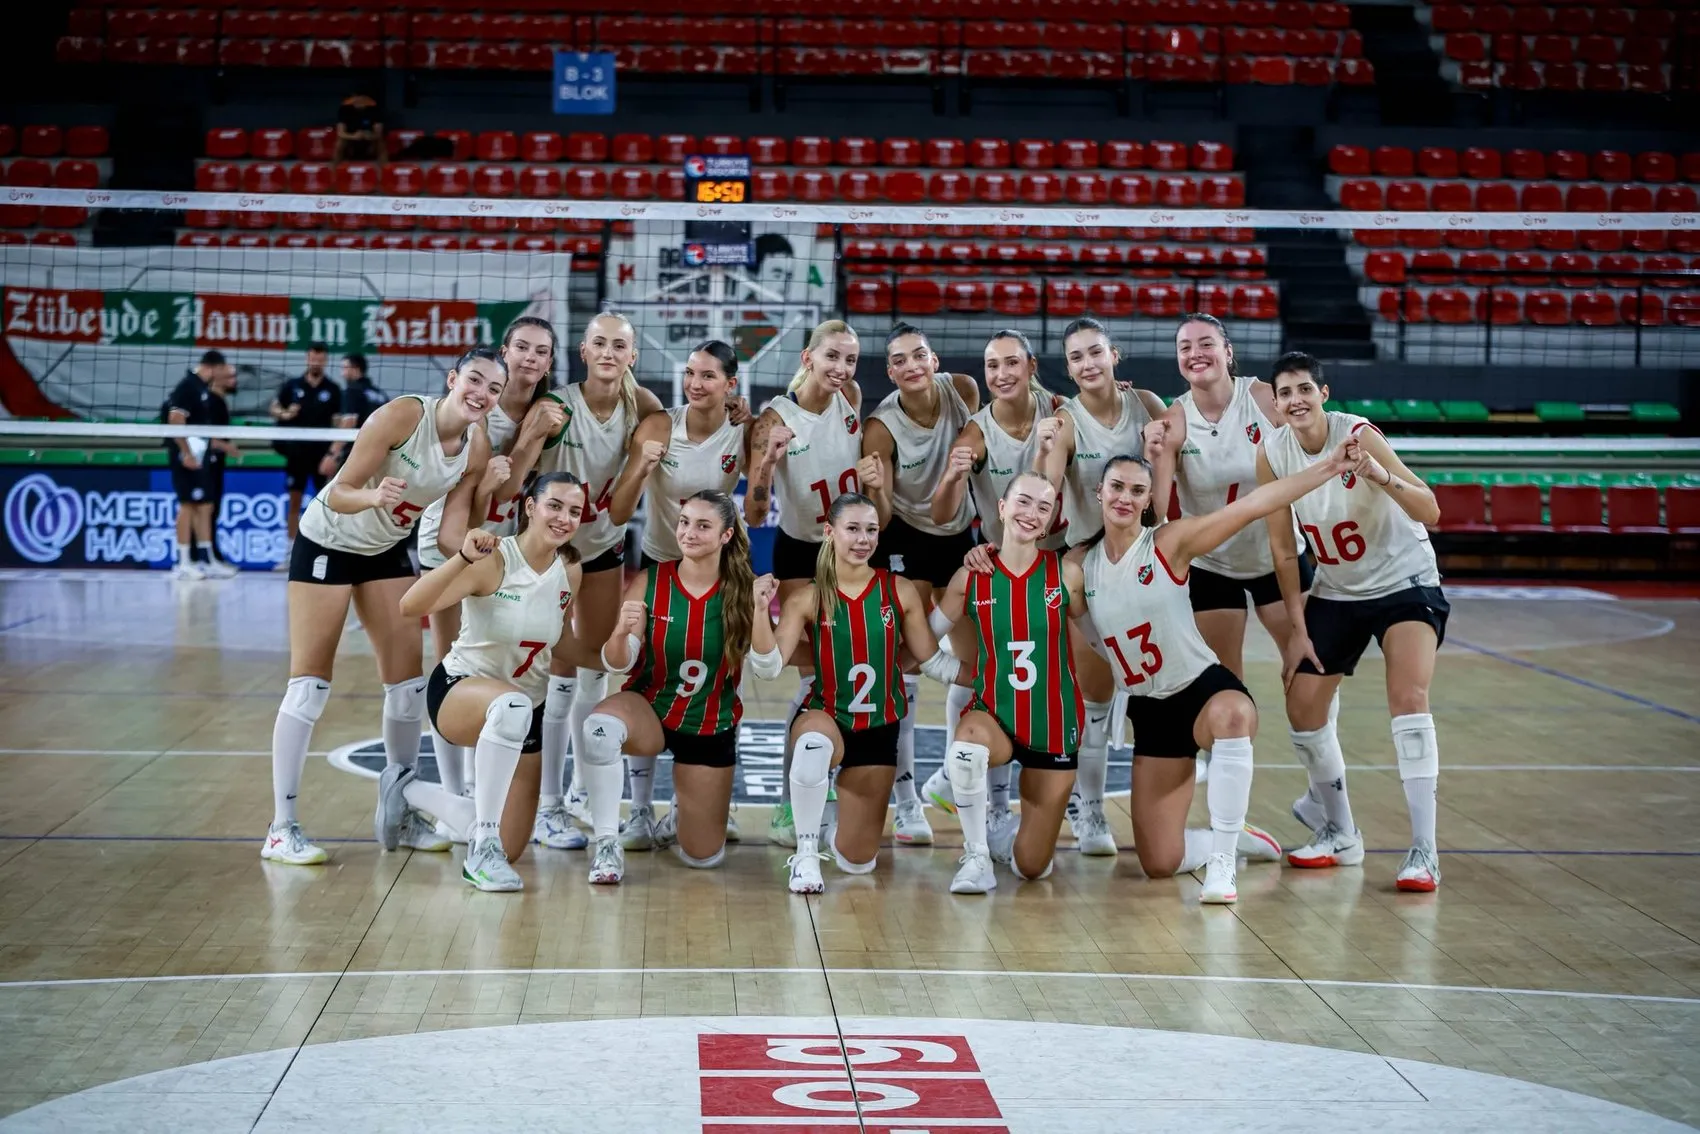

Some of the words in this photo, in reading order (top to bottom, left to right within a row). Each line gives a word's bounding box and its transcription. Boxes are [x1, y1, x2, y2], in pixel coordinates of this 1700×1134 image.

[559, 84, 609, 100] BLOK
[6, 290, 160, 345] Zübeyde
[86, 491, 290, 528] METPO
[392, 500, 425, 527] 5
[1302, 521, 1366, 565] 16
[512, 640, 547, 678] 7
[1007, 641, 1037, 690] 3
[1104, 622, 1163, 687] 13
[675, 659, 708, 697] 9
[847, 663, 877, 713] 2
